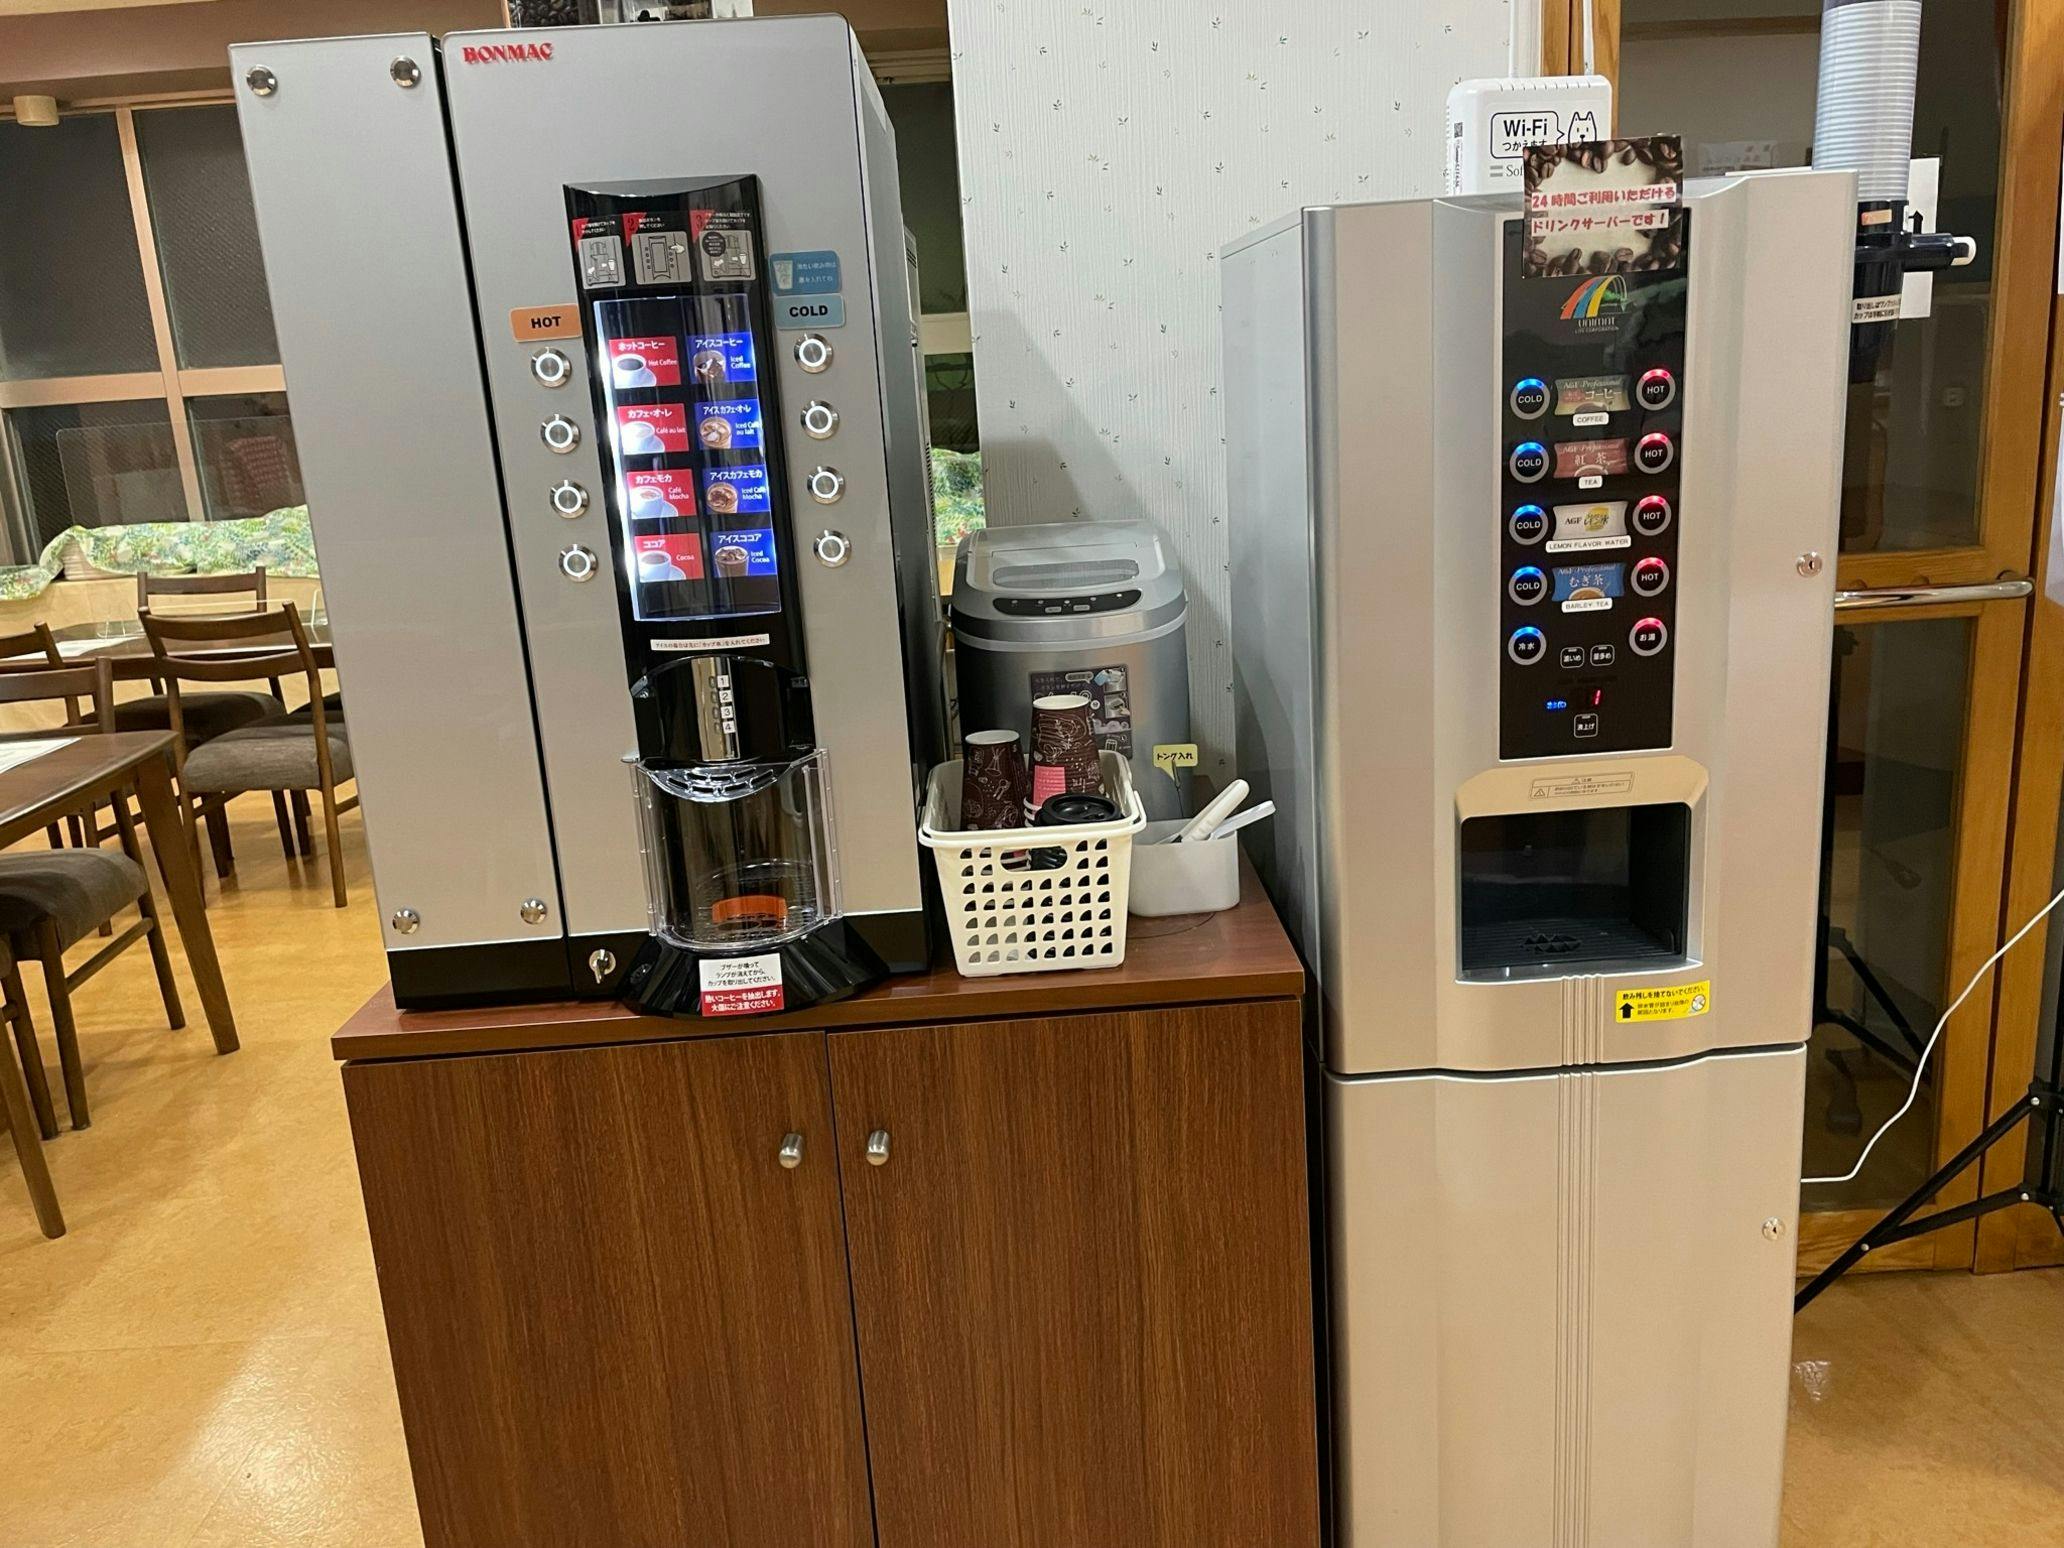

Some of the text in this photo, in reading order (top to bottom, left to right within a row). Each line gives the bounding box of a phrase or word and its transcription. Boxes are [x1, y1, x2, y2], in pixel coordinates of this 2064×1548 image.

[462, 43, 553, 64] BONMAC
[1503, 119, 1547, 137] Wi-Fi
[1506, 165, 1523, 177] Sof
[1532, 195, 1548, 208] 24
[789, 305, 828, 317] COLD
[531, 316, 561, 329] HOT
[618, 341, 665, 351] ホットコーヒー
[695, 338, 743, 348] アイスコーヒー
[1585, 388, 1622, 400] コーヒー
[1647, 385, 1665, 394] HOT
[1518, 395, 1543, 404] COLD
[1577, 415, 1604, 423] COFFEE
[1645, 449, 1663, 458] HOT
[1517, 460, 1542, 468] COLD
[635, 474, 672, 484] カフェモカ
[710, 470, 763, 480] アイスカフェモカ
[1584, 478, 1598, 486] TEA
[1643, 512, 1661, 520] HOT
[1516, 521, 1541, 529] COLD
[718, 533, 762, 543] アイスココア
[1605, 538, 1629, 546] WATER
[643, 539, 666, 549] ココア
[676, 553, 695, 561] Cocoa
[1569, 573, 1604, 587] むぎ茶
[1641, 573, 1659, 582] HOT
[1516, 582, 1540, 591] COLD
[1566, 602, 1592, 610] BARLEY
[720, 677, 725, 685] 1
[722, 692, 729, 700] 2
[724, 708, 731, 716] 3
[725, 723, 732, 731] 4
[1157, 752, 1193, 760] トング入れ
